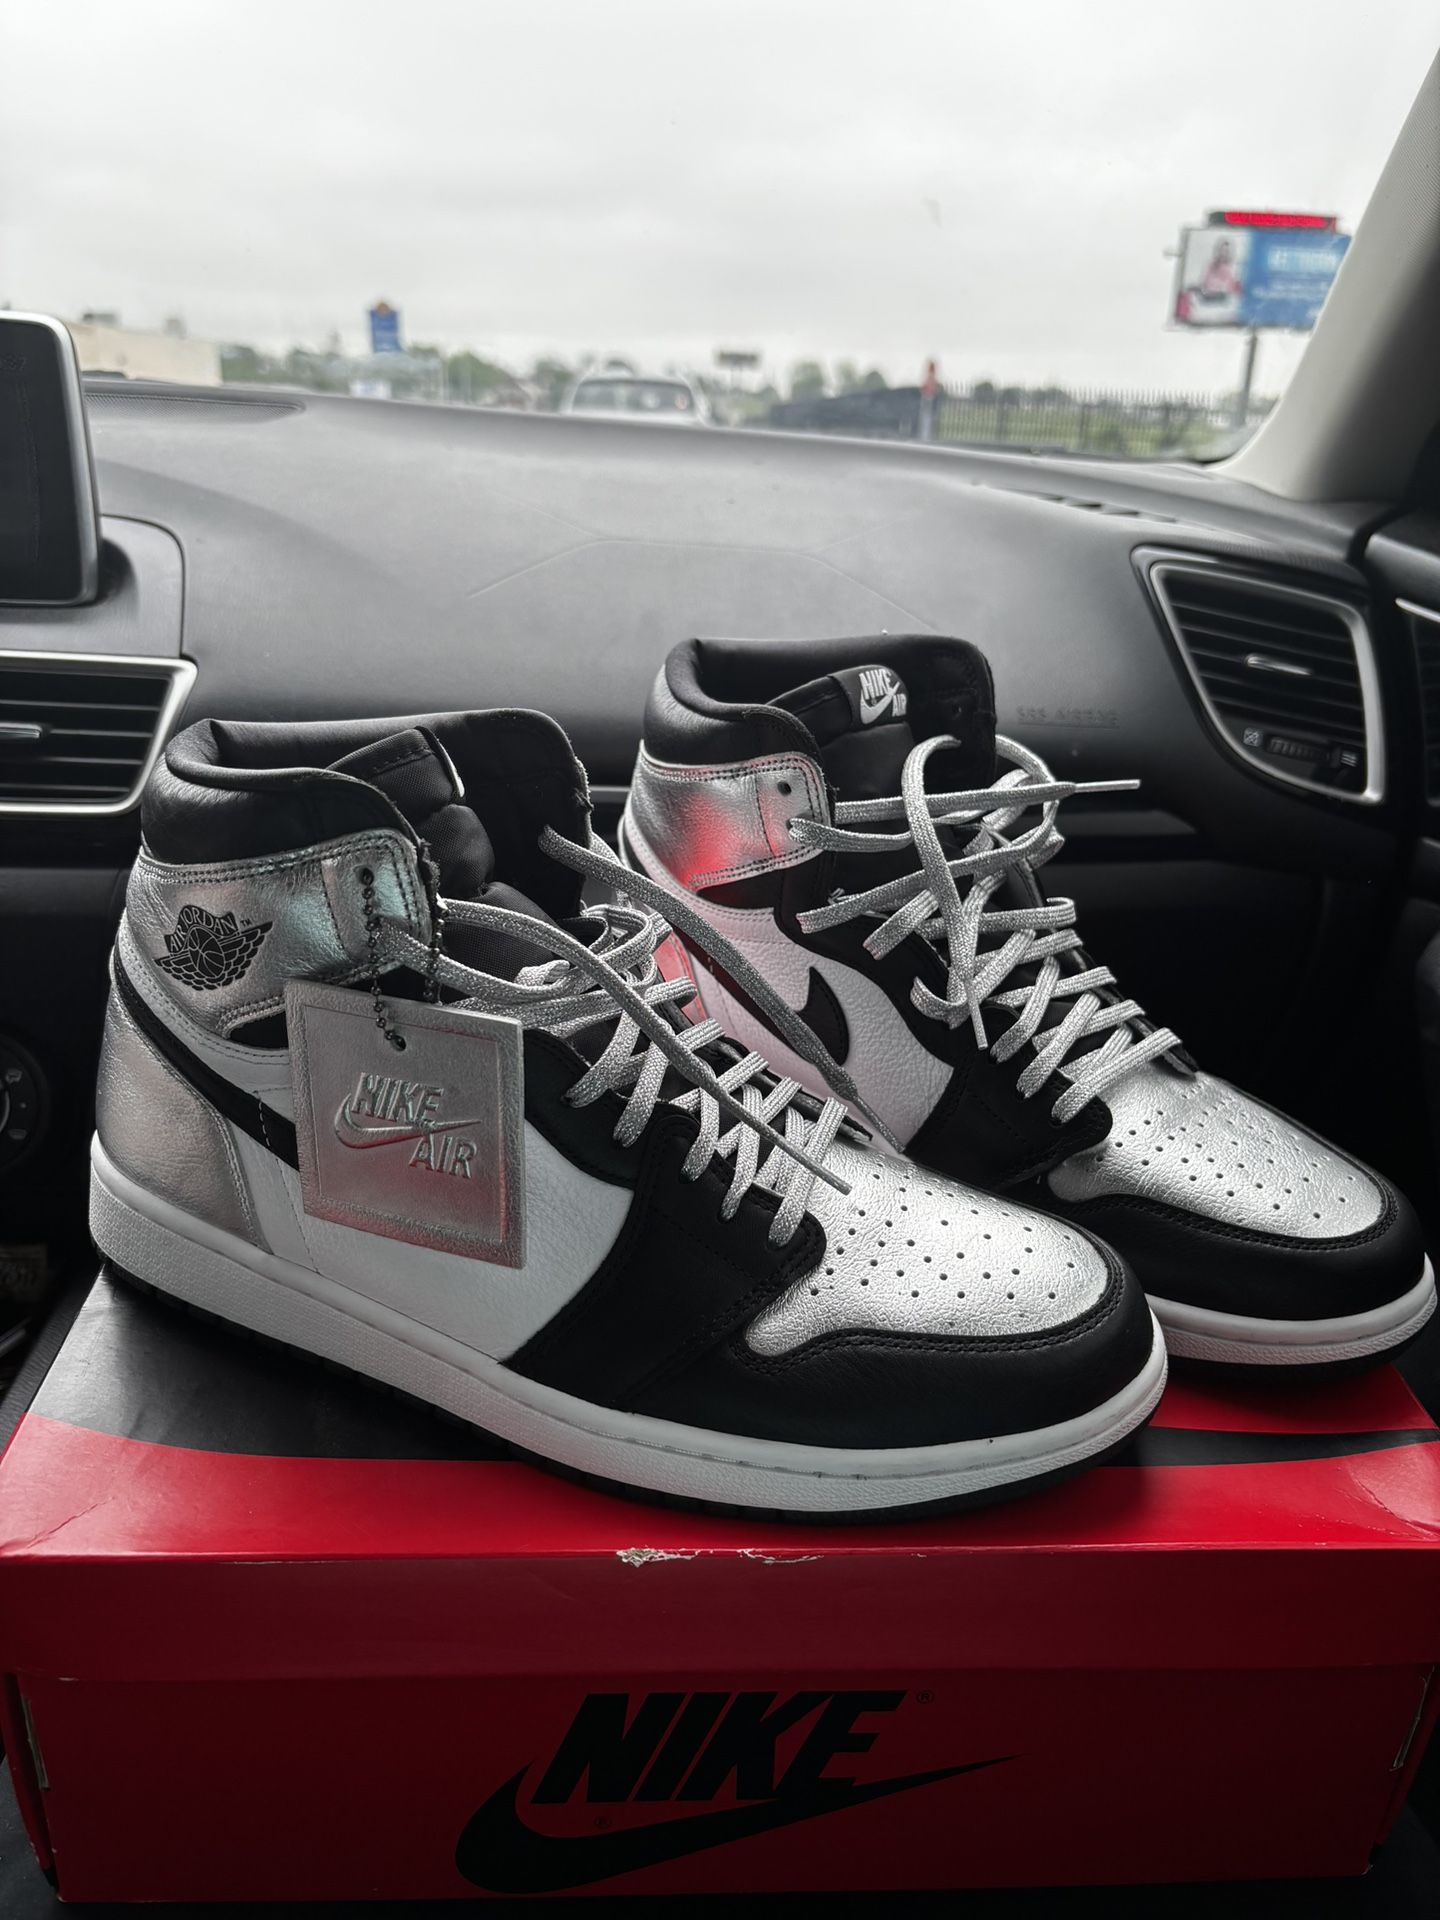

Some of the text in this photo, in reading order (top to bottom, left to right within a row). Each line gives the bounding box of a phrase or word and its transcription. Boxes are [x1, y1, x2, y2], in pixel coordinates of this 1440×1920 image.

[859, 668, 892, 700] NIKE
[169, 924, 187, 953] AIR
[180, 906, 239, 936] JORDAN
[350, 1071, 444, 1128] NIKE
[408, 1133, 477, 1179] AIR
[530, 1690, 908, 1804] NIKE
